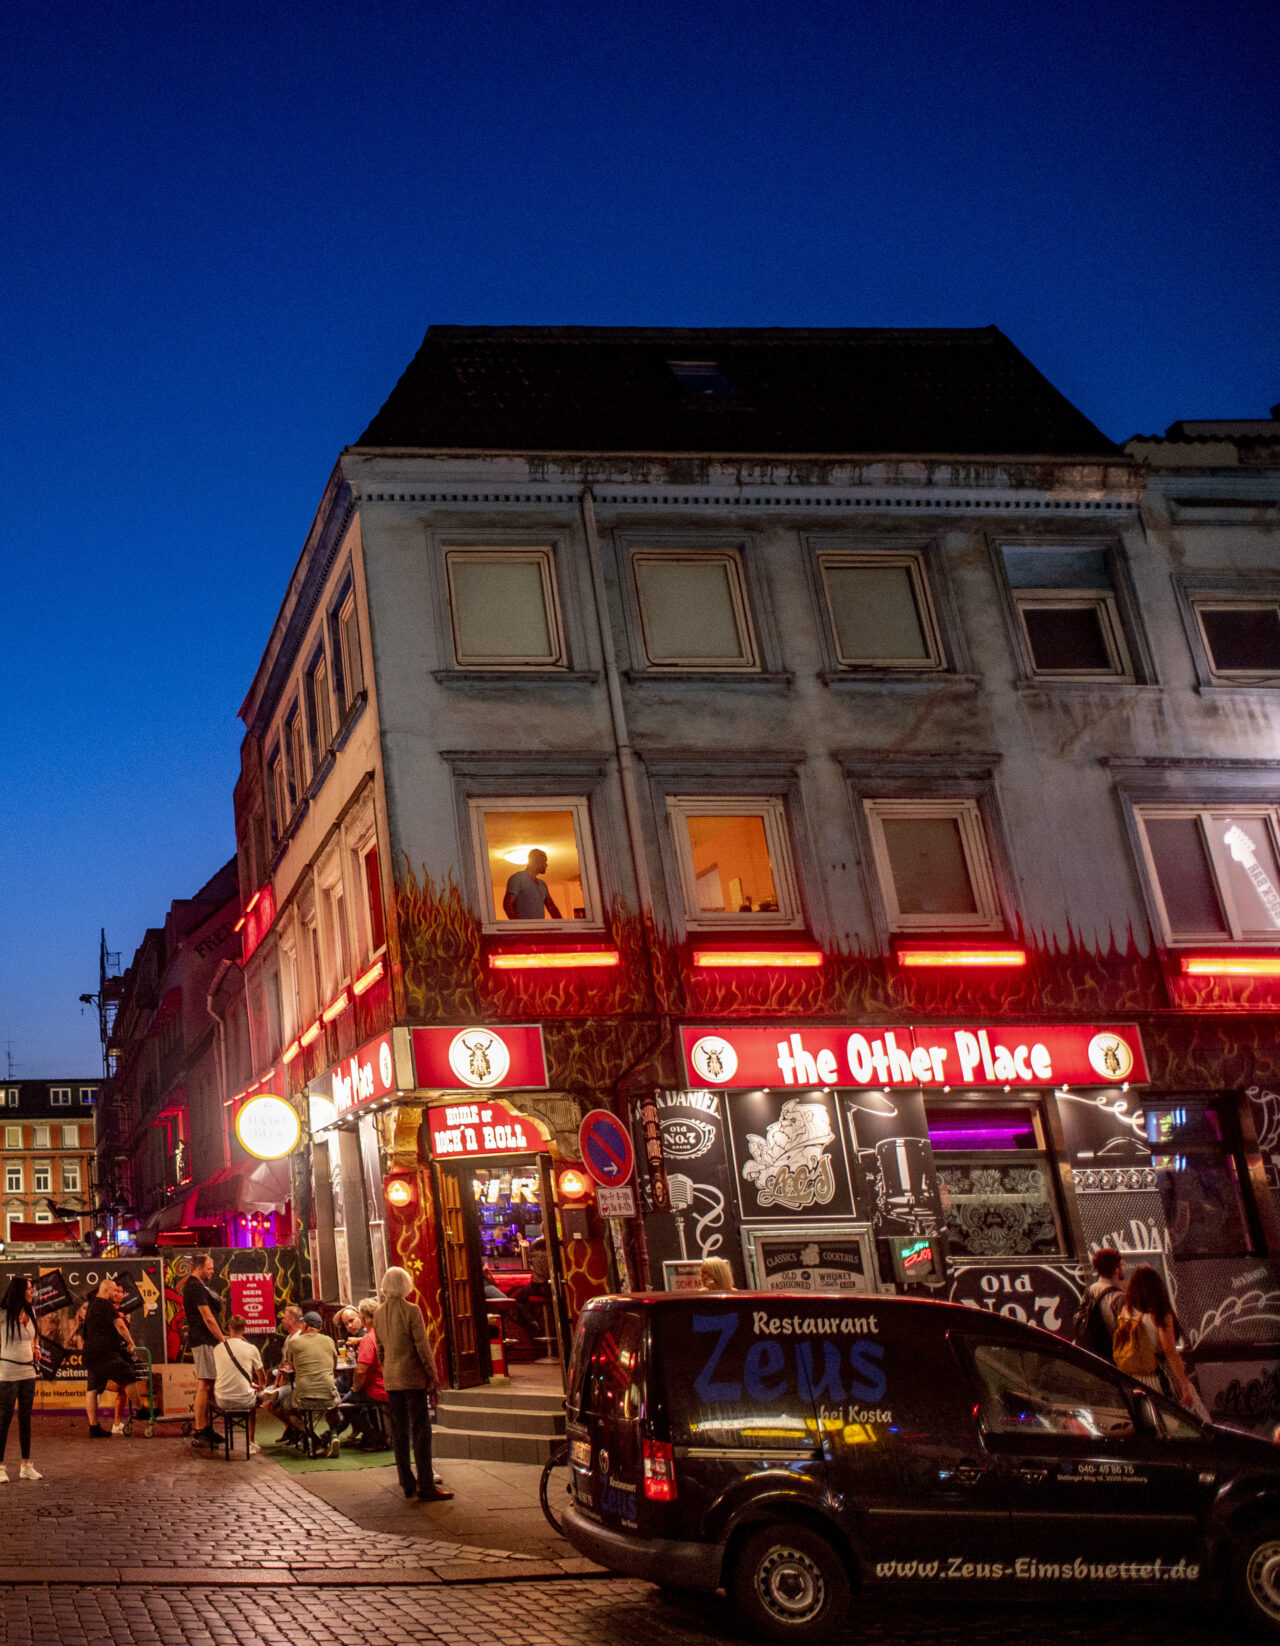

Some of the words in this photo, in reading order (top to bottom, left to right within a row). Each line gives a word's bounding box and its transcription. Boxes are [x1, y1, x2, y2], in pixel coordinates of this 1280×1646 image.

[777, 1033, 838, 1084] the
[847, 1031, 948, 1083] Other
[954, 1029, 1053, 1081] Place
[664, 1133, 696, 1145] No.7
[230, 1273, 273, 1281] ENTRY
[770, 1280, 811, 1290] FASHIONED
[781, 1271, 797, 1281] OLD
[981, 1274, 1033, 1293] Old
[142, 1289, 157, 1297] 18+
[752, 1311, 880, 1335] Restaurant
[692, 1312, 887, 1403] Zeus
[820, 1404, 844, 1425] bei
[848, 1404, 893, 1424] Kosta
[875, 1556, 1200, 1581] www.Zeus-Eimsbuettel.de
